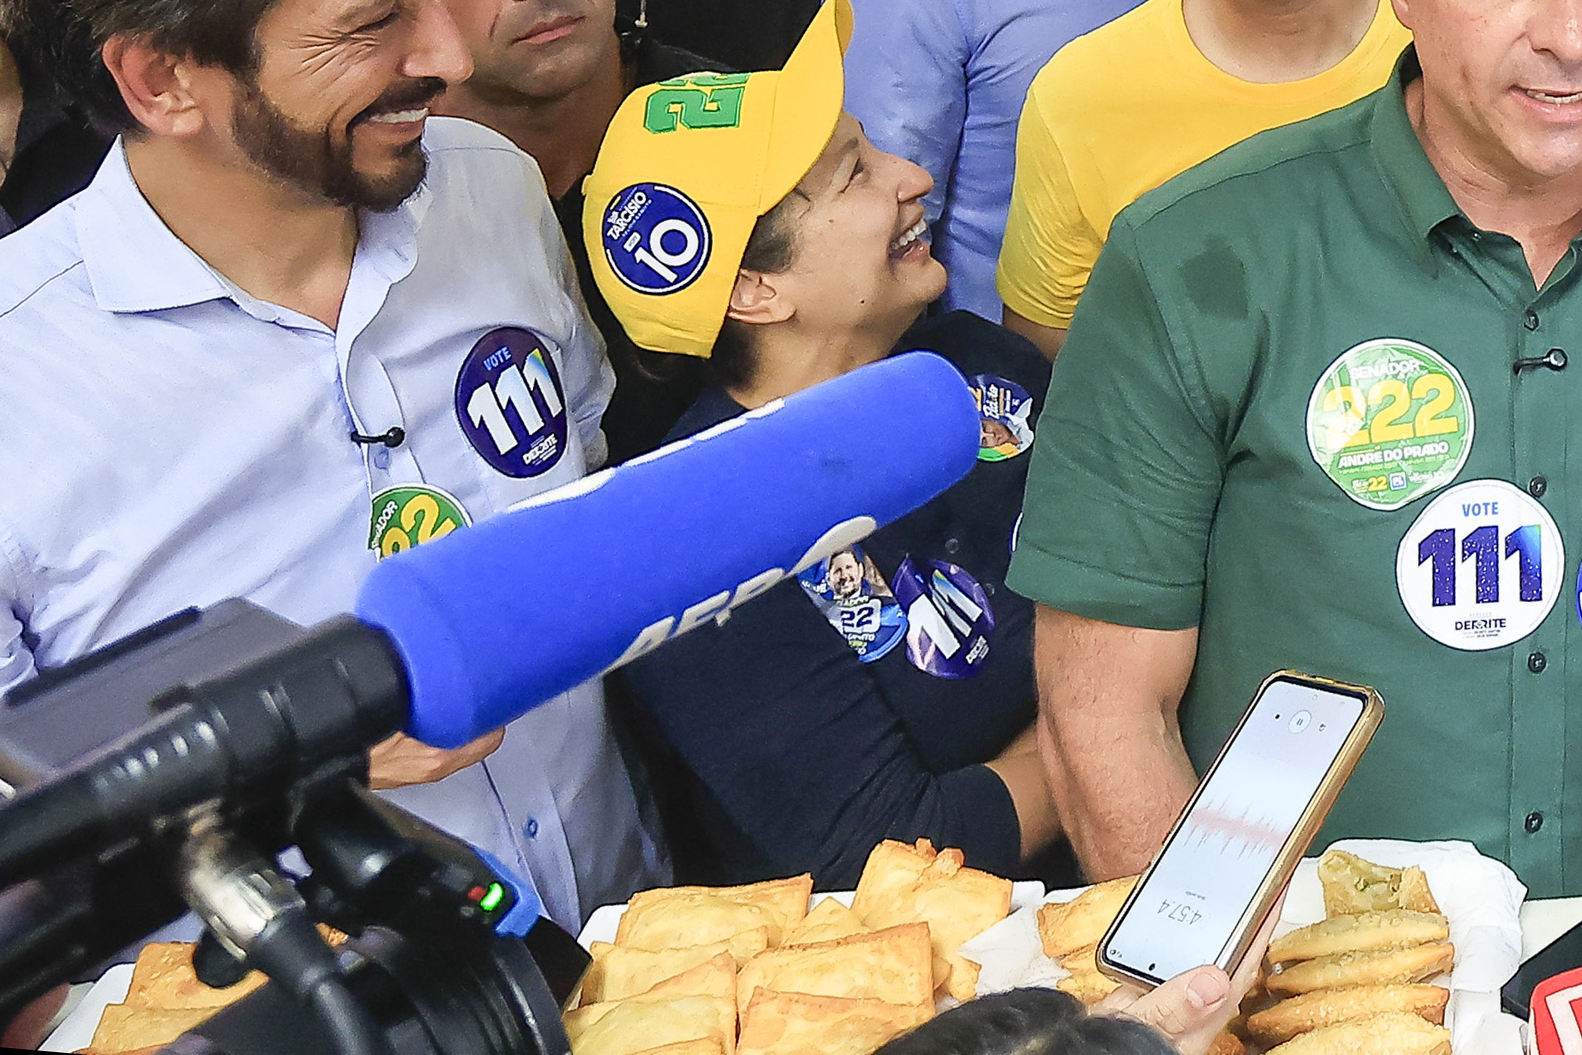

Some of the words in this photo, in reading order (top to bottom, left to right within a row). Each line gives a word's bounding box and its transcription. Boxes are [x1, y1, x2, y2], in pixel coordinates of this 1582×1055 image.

[634, 218, 700, 284] 10
[483, 346, 513, 372] VOTE
[1350, 358, 1421, 380] SENADOR
[466, 347, 564, 456] 111
[1322, 372, 1459, 453] 222
[1383, 449, 1403, 462] DO
[1403, 441, 1450, 459] PRADO
[1368, 475, 1389, 492] 22
[1461, 501, 1499, 517] VOTE
[1418, 524, 1543, 608] 111
[840, 606, 875, 628] 22
[1454, 617, 1507, 631] DERRITE
